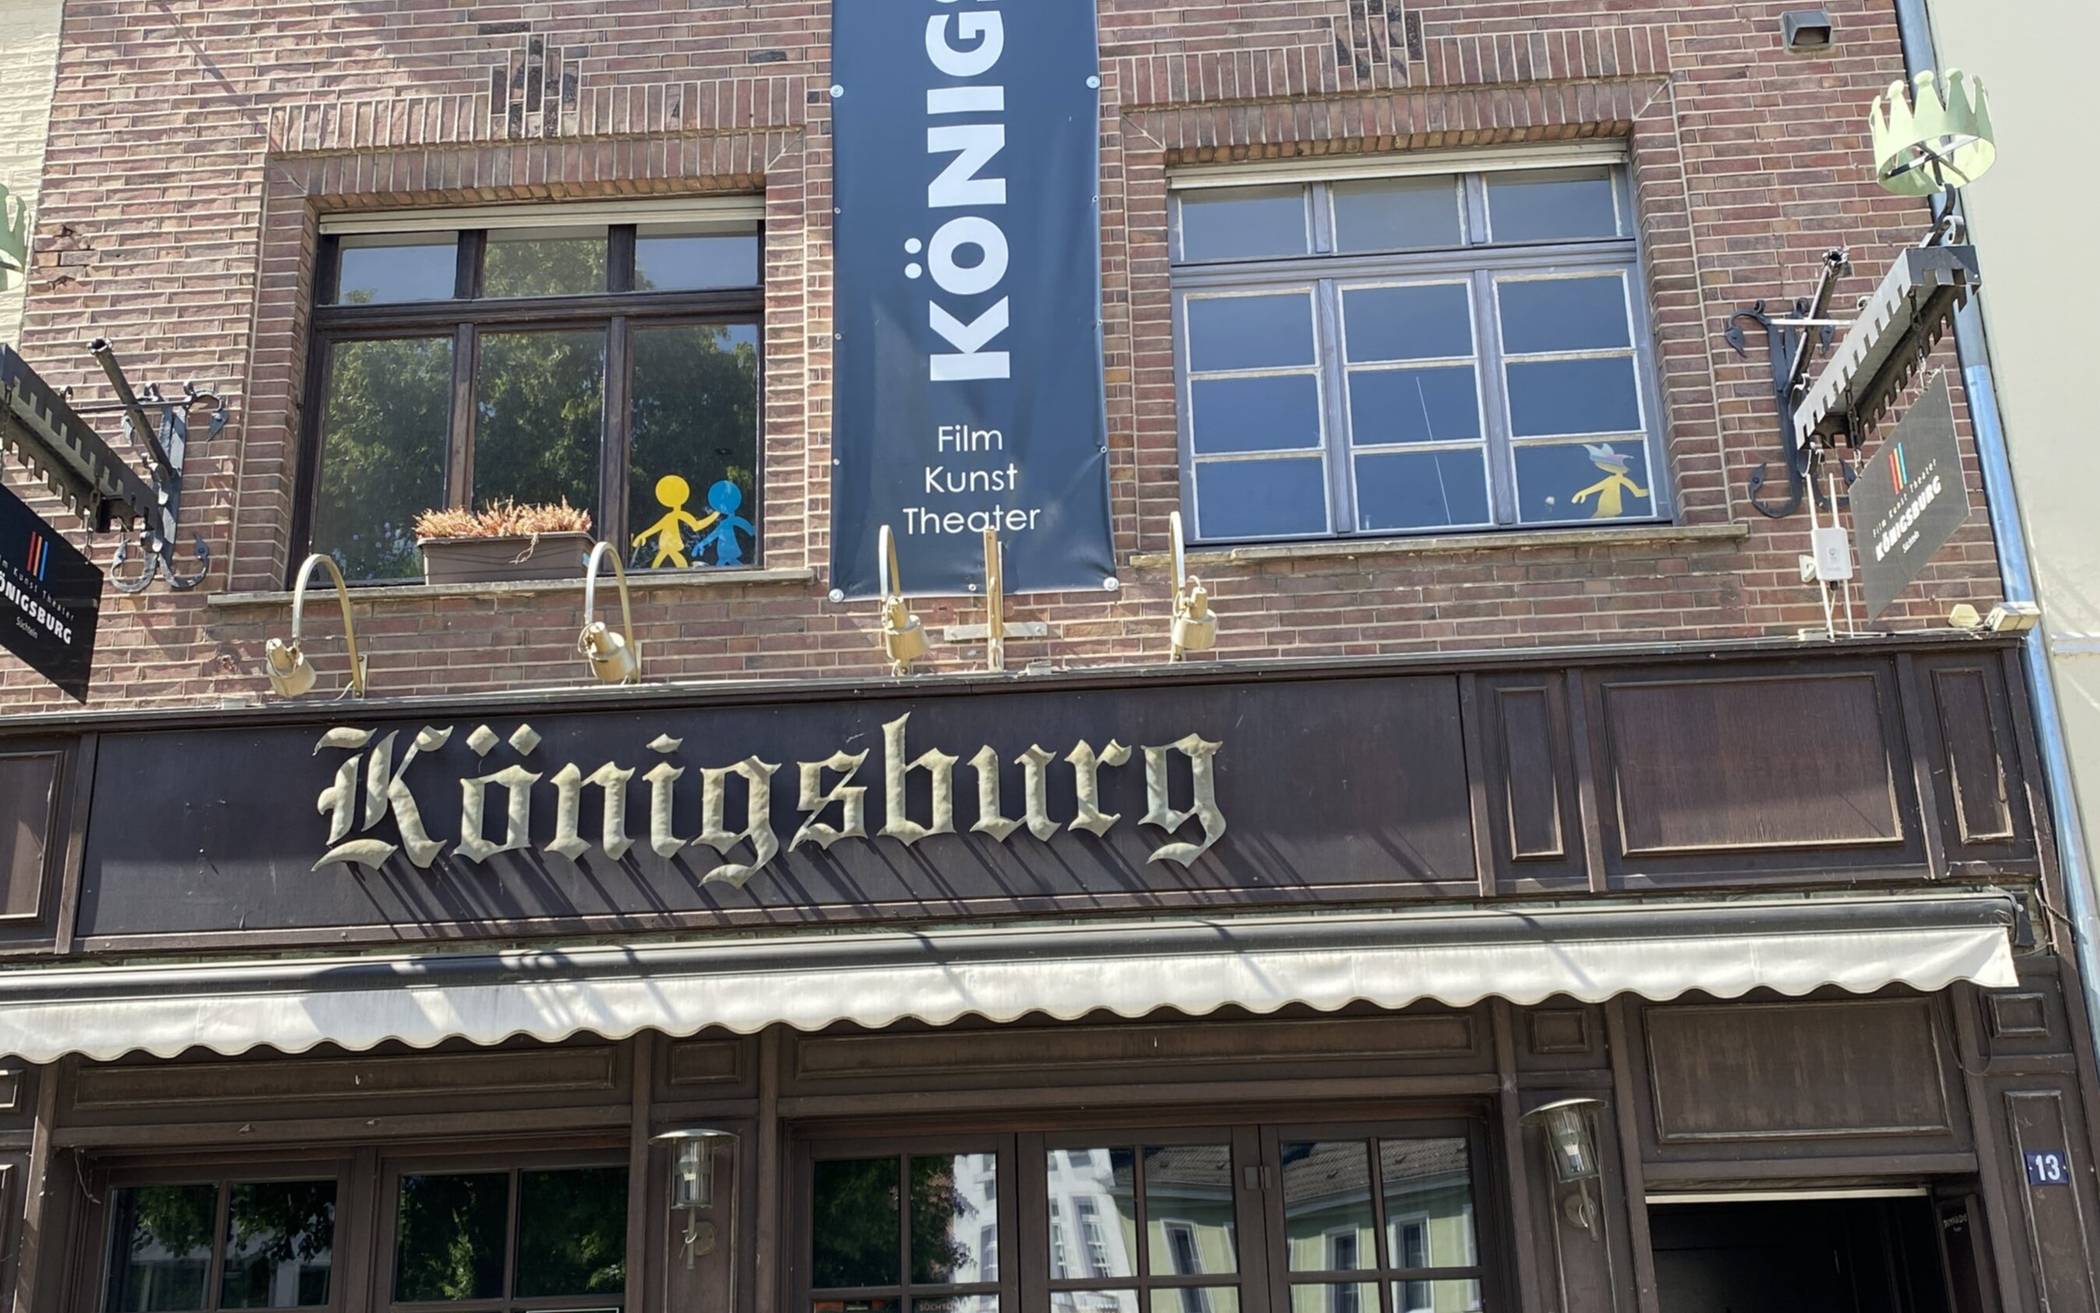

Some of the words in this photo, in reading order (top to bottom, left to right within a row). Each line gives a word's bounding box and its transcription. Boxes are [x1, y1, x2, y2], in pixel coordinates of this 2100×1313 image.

[904, 0, 1011, 382] KÖNIG
[938, 424, 1003, 452] Film
[925, 463, 1018, 493] Kunst
[902, 504, 1041, 535] Theater
[1875, 475, 1942, 562] KÖNIGSBURG
[311, 711, 1228, 890] Königsburg
[2035, 1154, 2061, 1181] 13
